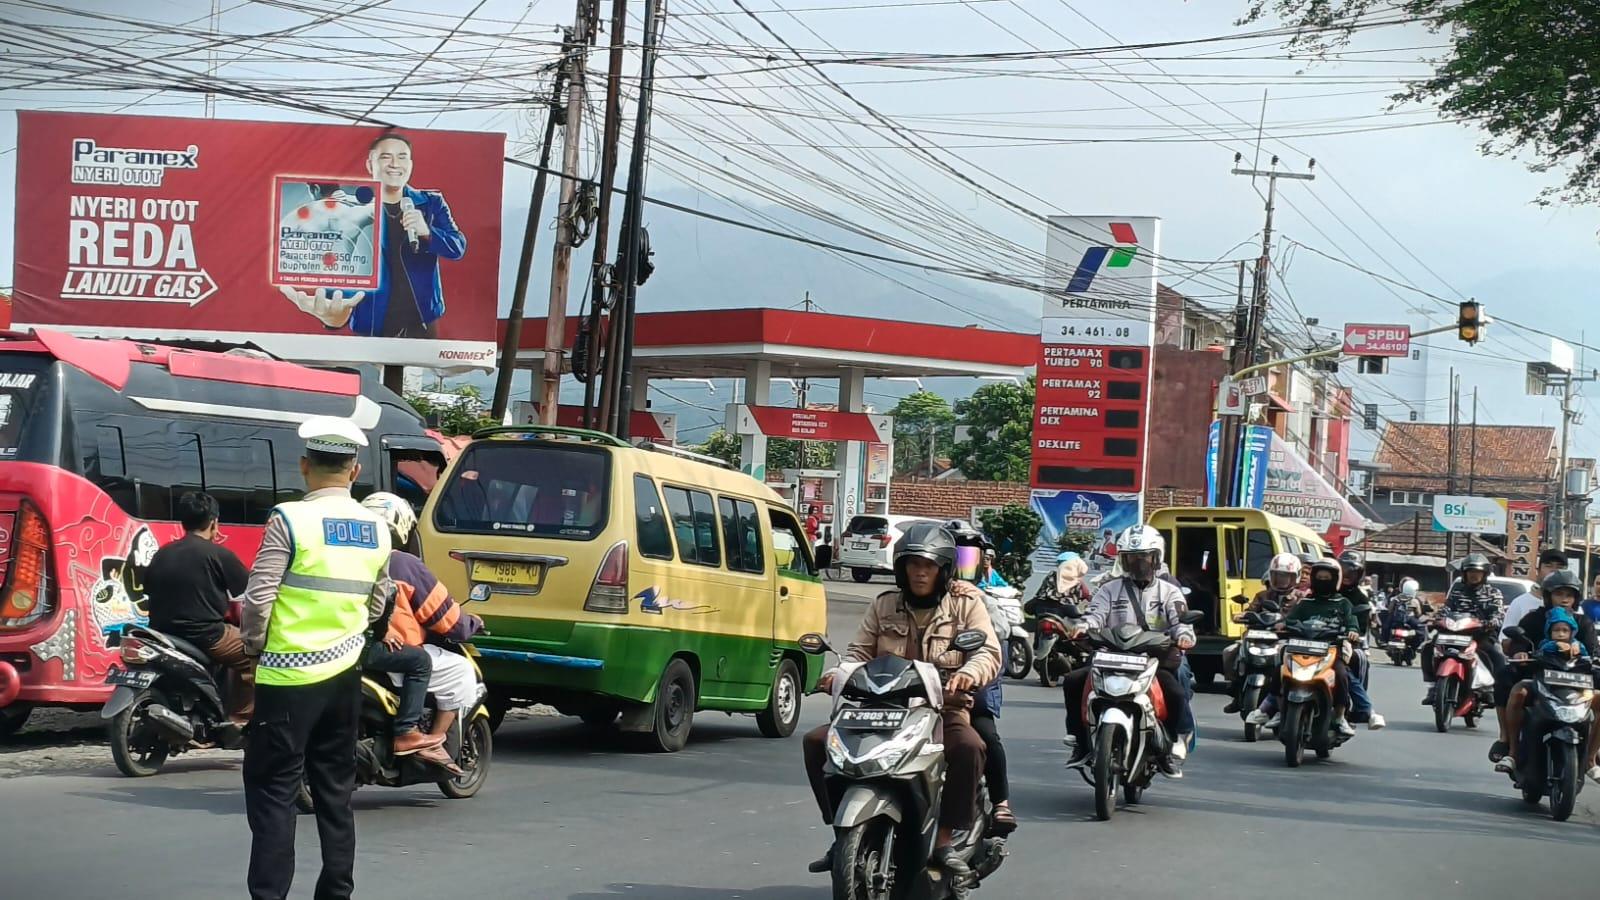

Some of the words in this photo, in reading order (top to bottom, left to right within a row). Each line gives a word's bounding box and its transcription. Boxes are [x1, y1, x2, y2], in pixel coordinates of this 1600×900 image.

[74, 140, 195, 167] Paramex
[74, 166, 118, 182] NYERI
[123, 169, 161, 184] OTOT
[70, 195, 136, 219] NYERI
[142, 198, 199, 221] OTOT
[281, 227, 343, 240] Paramex
[69, 219, 197, 269] REDA
[280, 261, 321, 273] Ibuprofen
[341, 264, 355, 273] mg
[62, 271, 152, 296] LANJUT
[154, 275, 203, 298] GAS
[1062, 299, 1131, 310] PERTAMINA
[1367, 329, 1405, 341] SPBU
[438, 350, 485, 361] KONIMEX
[1044, 347, 1103, 358] PERTAMAX
[1044, 357, 1080, 367] TURBO
[1042, 379, 1101, 389] PERTAMAX
[1087, 390, 1101, 399] 92
[1040, 406, 1098, 416] PERTAMINA
[527, 415, 533, 424] 2
[743, 417, 748, 427] 1
[1040, 416, 1060, 425] DEX
[1038, 440, 1081, 450] DEXLITE
[1304, 498, 1337, 508] PADANG
[1263, 503, 1305, 518] CAHAYO
[1308, 506, 1342, 521] ADAM
[1444, 503, 1465, 516] BSI
[1067, 517, 1098, 527] SIAGA
[1513, 512, 1536, 521] RM
[326, 521, 377, 544] POLISI
